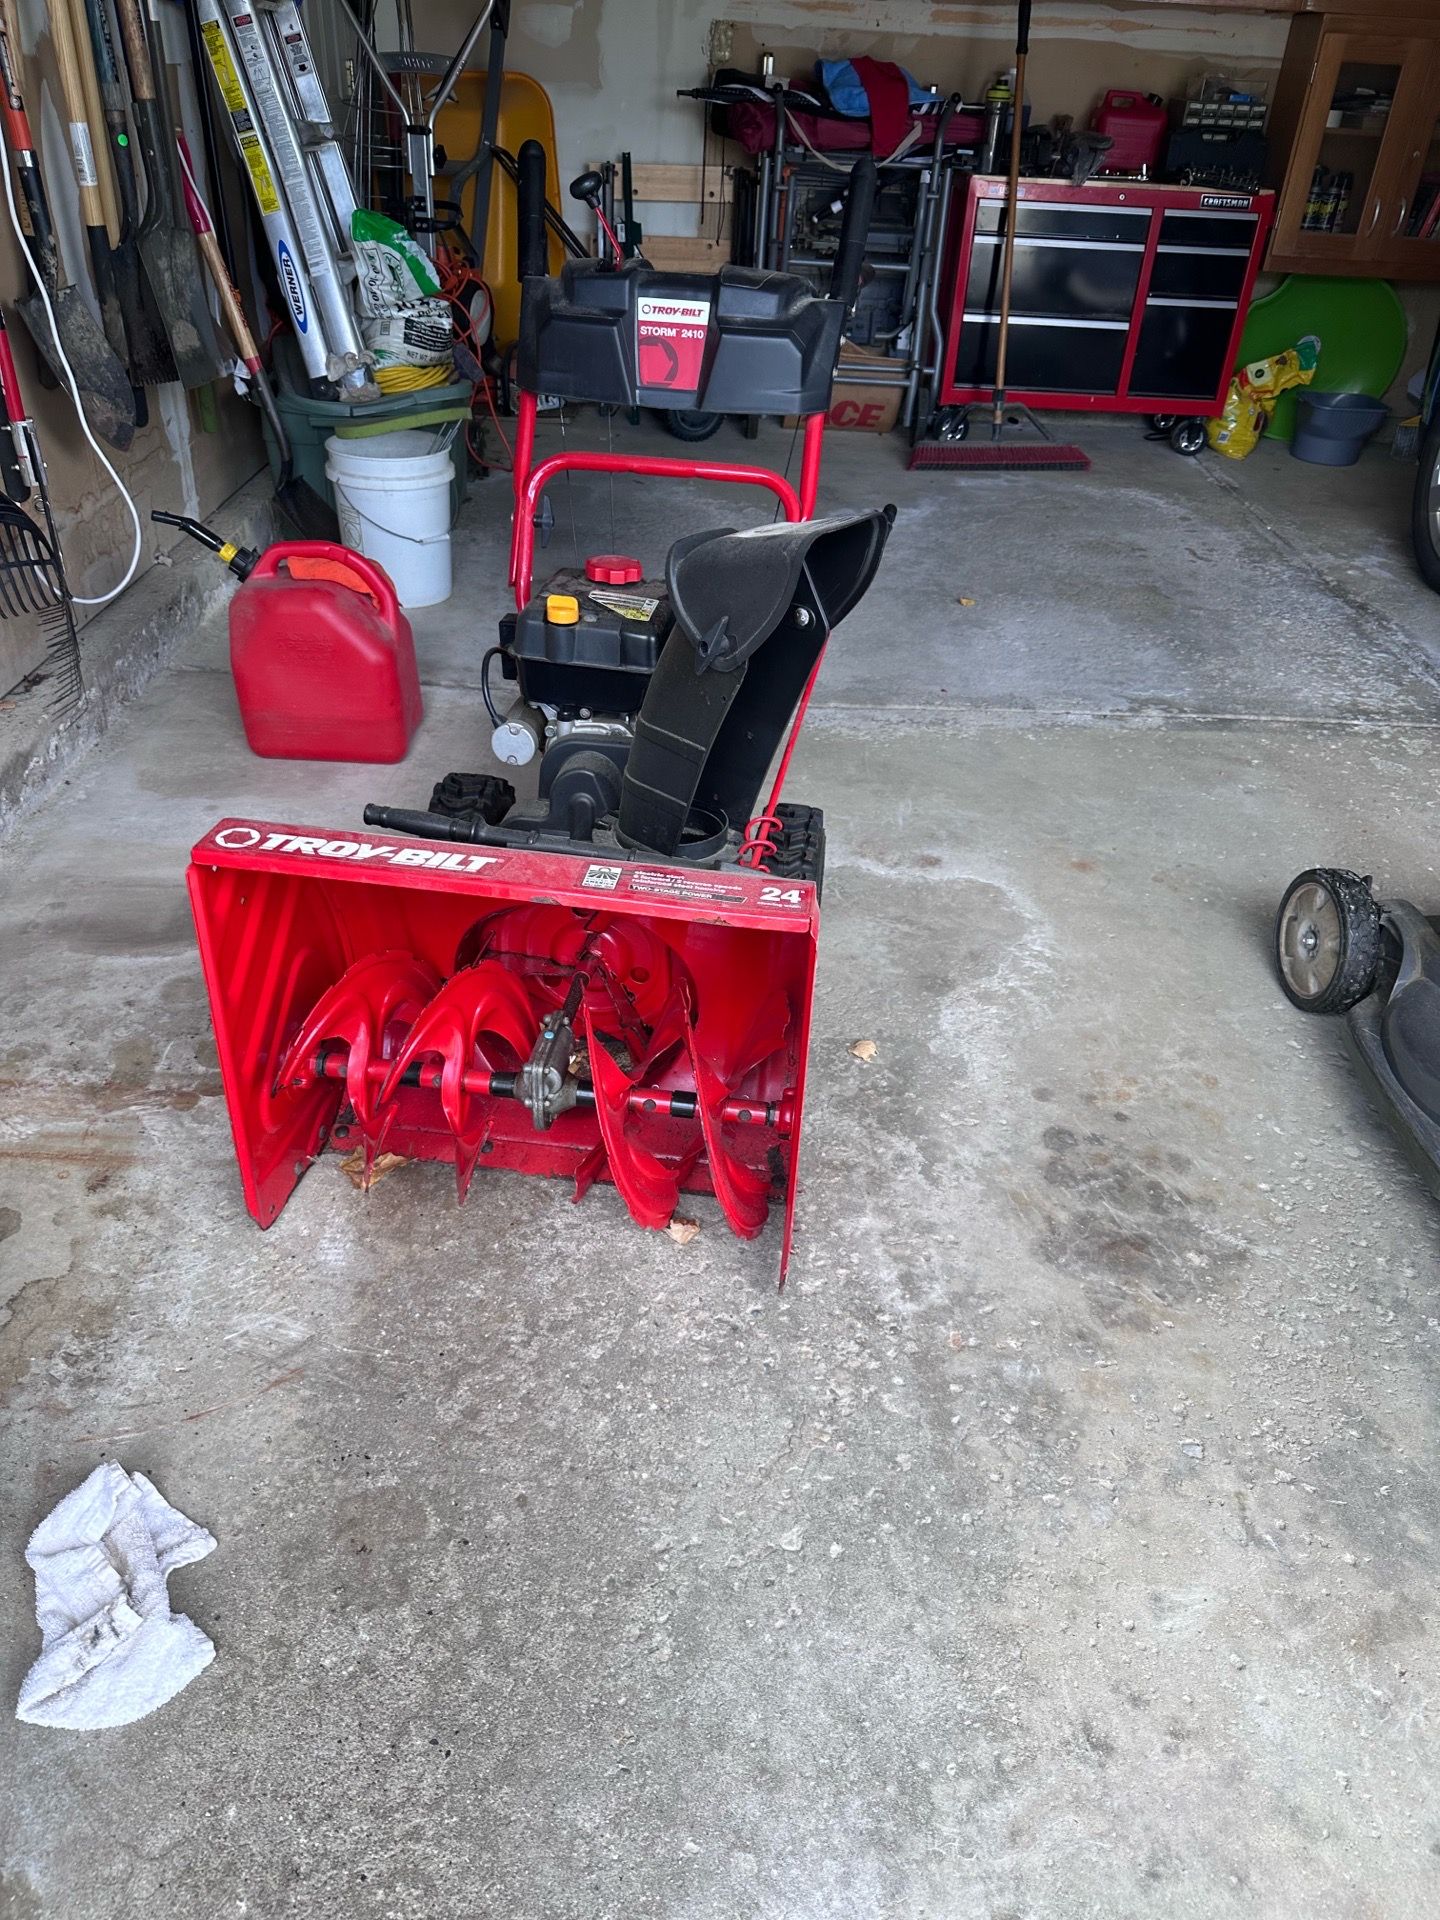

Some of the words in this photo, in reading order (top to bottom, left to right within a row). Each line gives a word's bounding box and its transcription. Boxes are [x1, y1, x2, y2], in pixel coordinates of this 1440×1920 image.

[1203, 197, 1249, 208] CRAFTSMAN
[282, 257, 304, 316] WERNER
[651, 305, 704, 318] TROY-BILT
[681, 329, 705, 339] 2410
[258, 833, 499, 873] TROY-BILT
[681, 890, 712, 899] POWER
